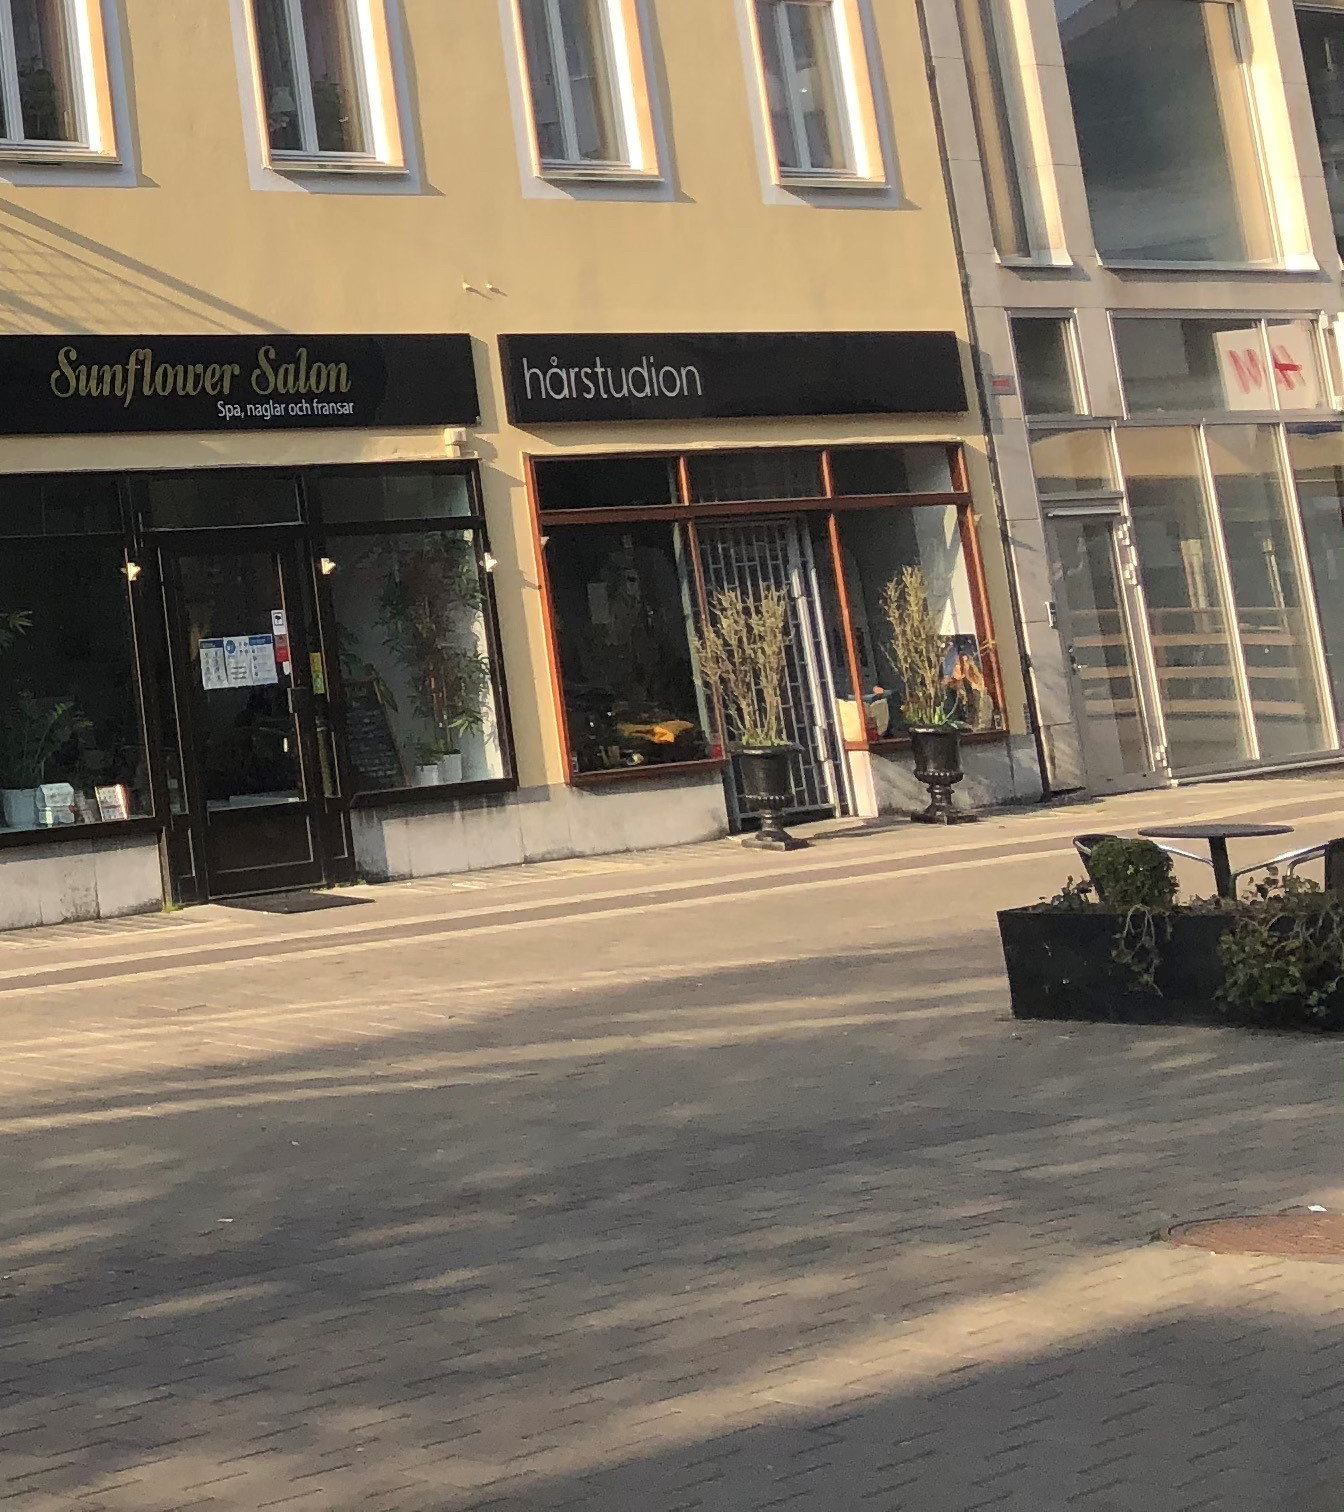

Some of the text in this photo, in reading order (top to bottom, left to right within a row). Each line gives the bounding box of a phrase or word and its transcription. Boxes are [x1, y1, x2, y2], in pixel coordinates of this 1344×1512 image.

[50, 345, 351, 407] Sunflower Salon
[522, 355, 703, 400] hårstudion
[217, 398, 354, 420] Spa, naglar och fransar
